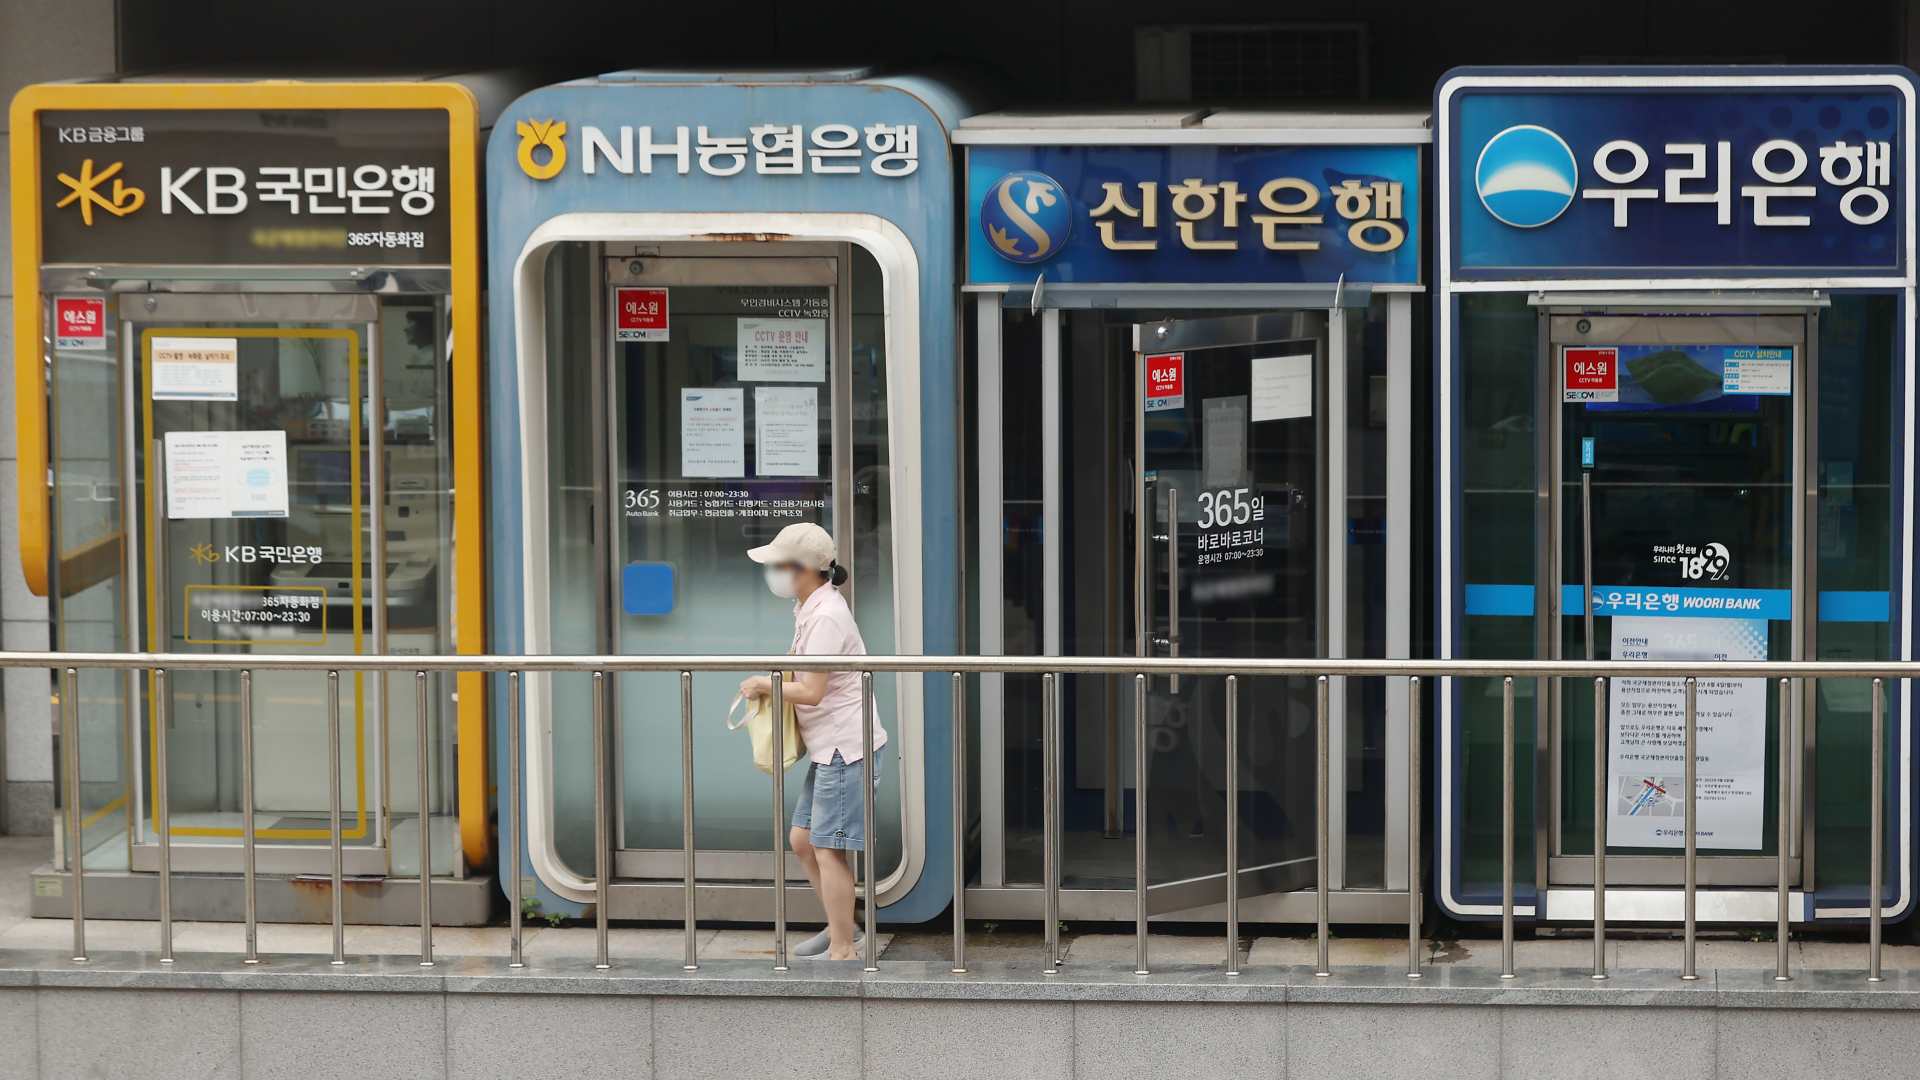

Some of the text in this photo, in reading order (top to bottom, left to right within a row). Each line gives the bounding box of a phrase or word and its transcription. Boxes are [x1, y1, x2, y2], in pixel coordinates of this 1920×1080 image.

[581, 122, 919, 177] NH농협은행
[1582, 139, 1892, 228] 우리은행
[1089, 176, 1405, 253] 신한은행
[348, 231, 424, 248] 365자동화점
[626, 301, 658, 315] 에스원
[778, 309, 800, 318] CCTV
[64, 310, 96, 324] 에스원
[754, 330, 775, 342] CCTV
[1152, 368, 1176, 382] 에스원
[1574, 361, 1608, 375] 에스원
[624, 488, 660, 508] 365
[1198, 528, 1264, 551] 바로바로코너
[1653, 545, 1676, 553] 우리나라
[1676, 544, 1684, 554] 첫
[1198, 548, 1264, 565] 운영시간 07:00~23:30
[1606, 592, 1761, 612] 우리은행 WOORI BANK
[1622, 638, 1648, 646] 이전안내
[1622, 651, 1648, 660] 우리은행
